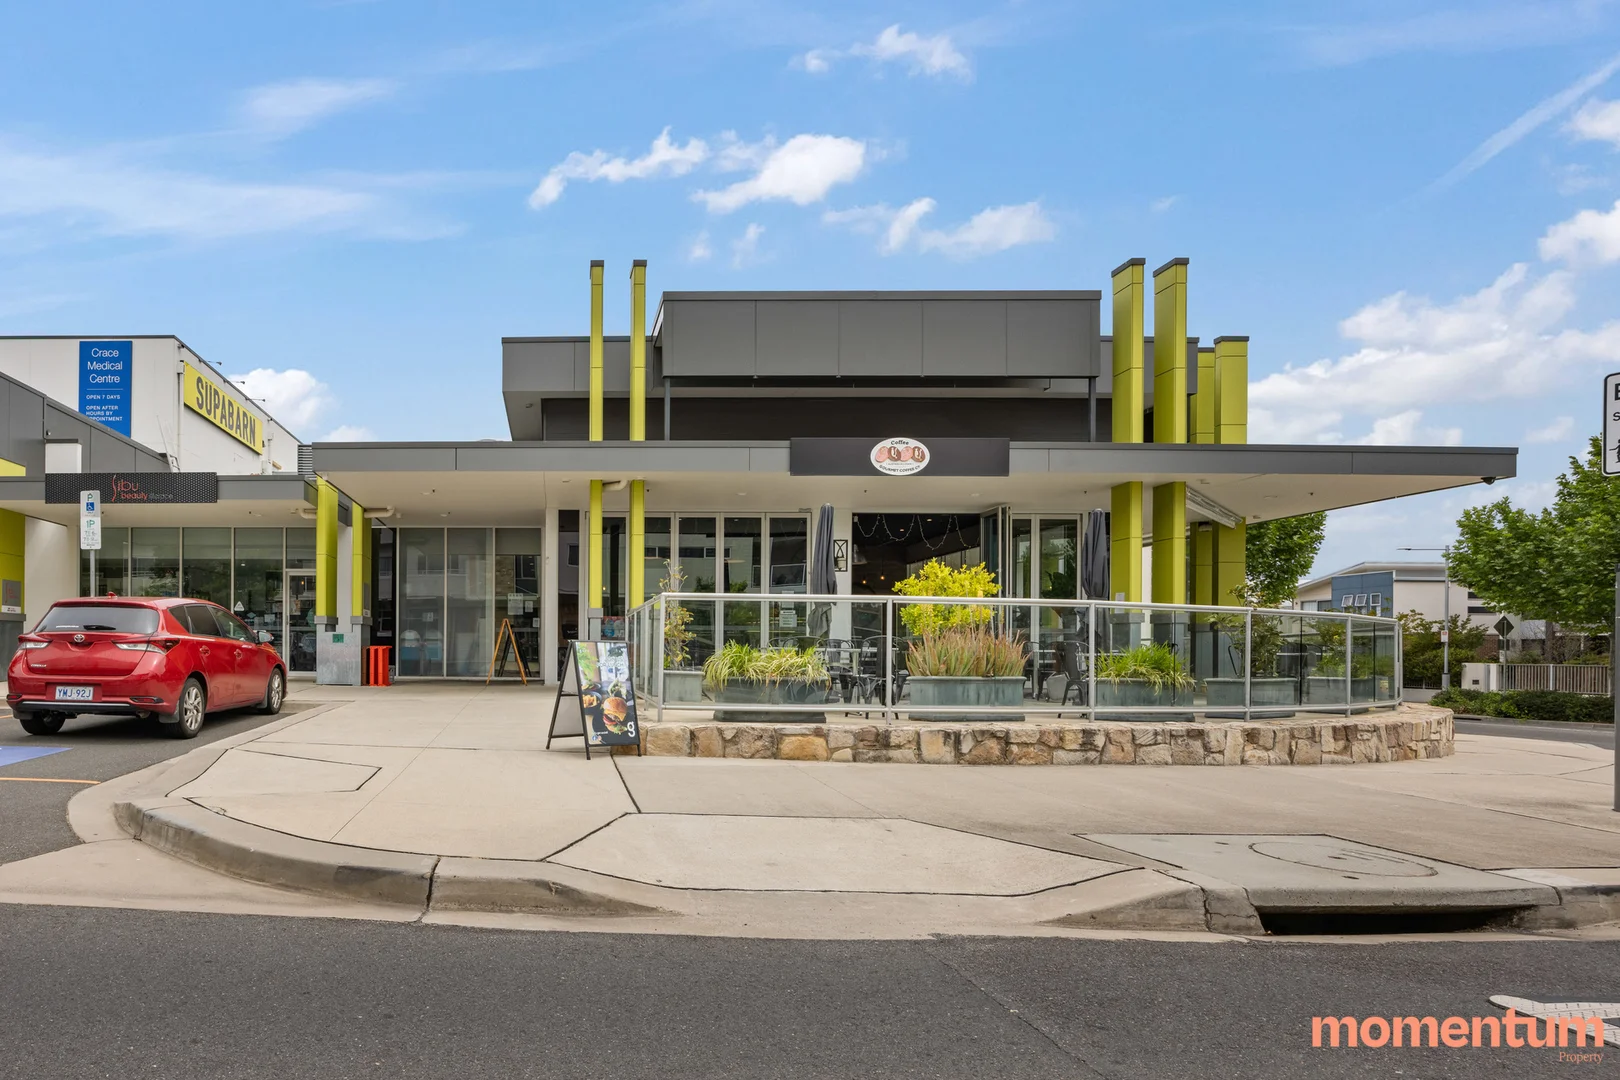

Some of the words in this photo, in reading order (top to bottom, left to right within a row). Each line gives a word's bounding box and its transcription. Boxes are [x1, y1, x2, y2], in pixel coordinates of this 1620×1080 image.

[91, 348, 119, 358] Crace
[87, 361, 123, 371] Medical
[89, 373, 121, 384] Centre
[196, 376, 256, 447] SUPABARN
[879, 464, 898, 472] GOURMET
[121, 492, 148, 500] beauty
